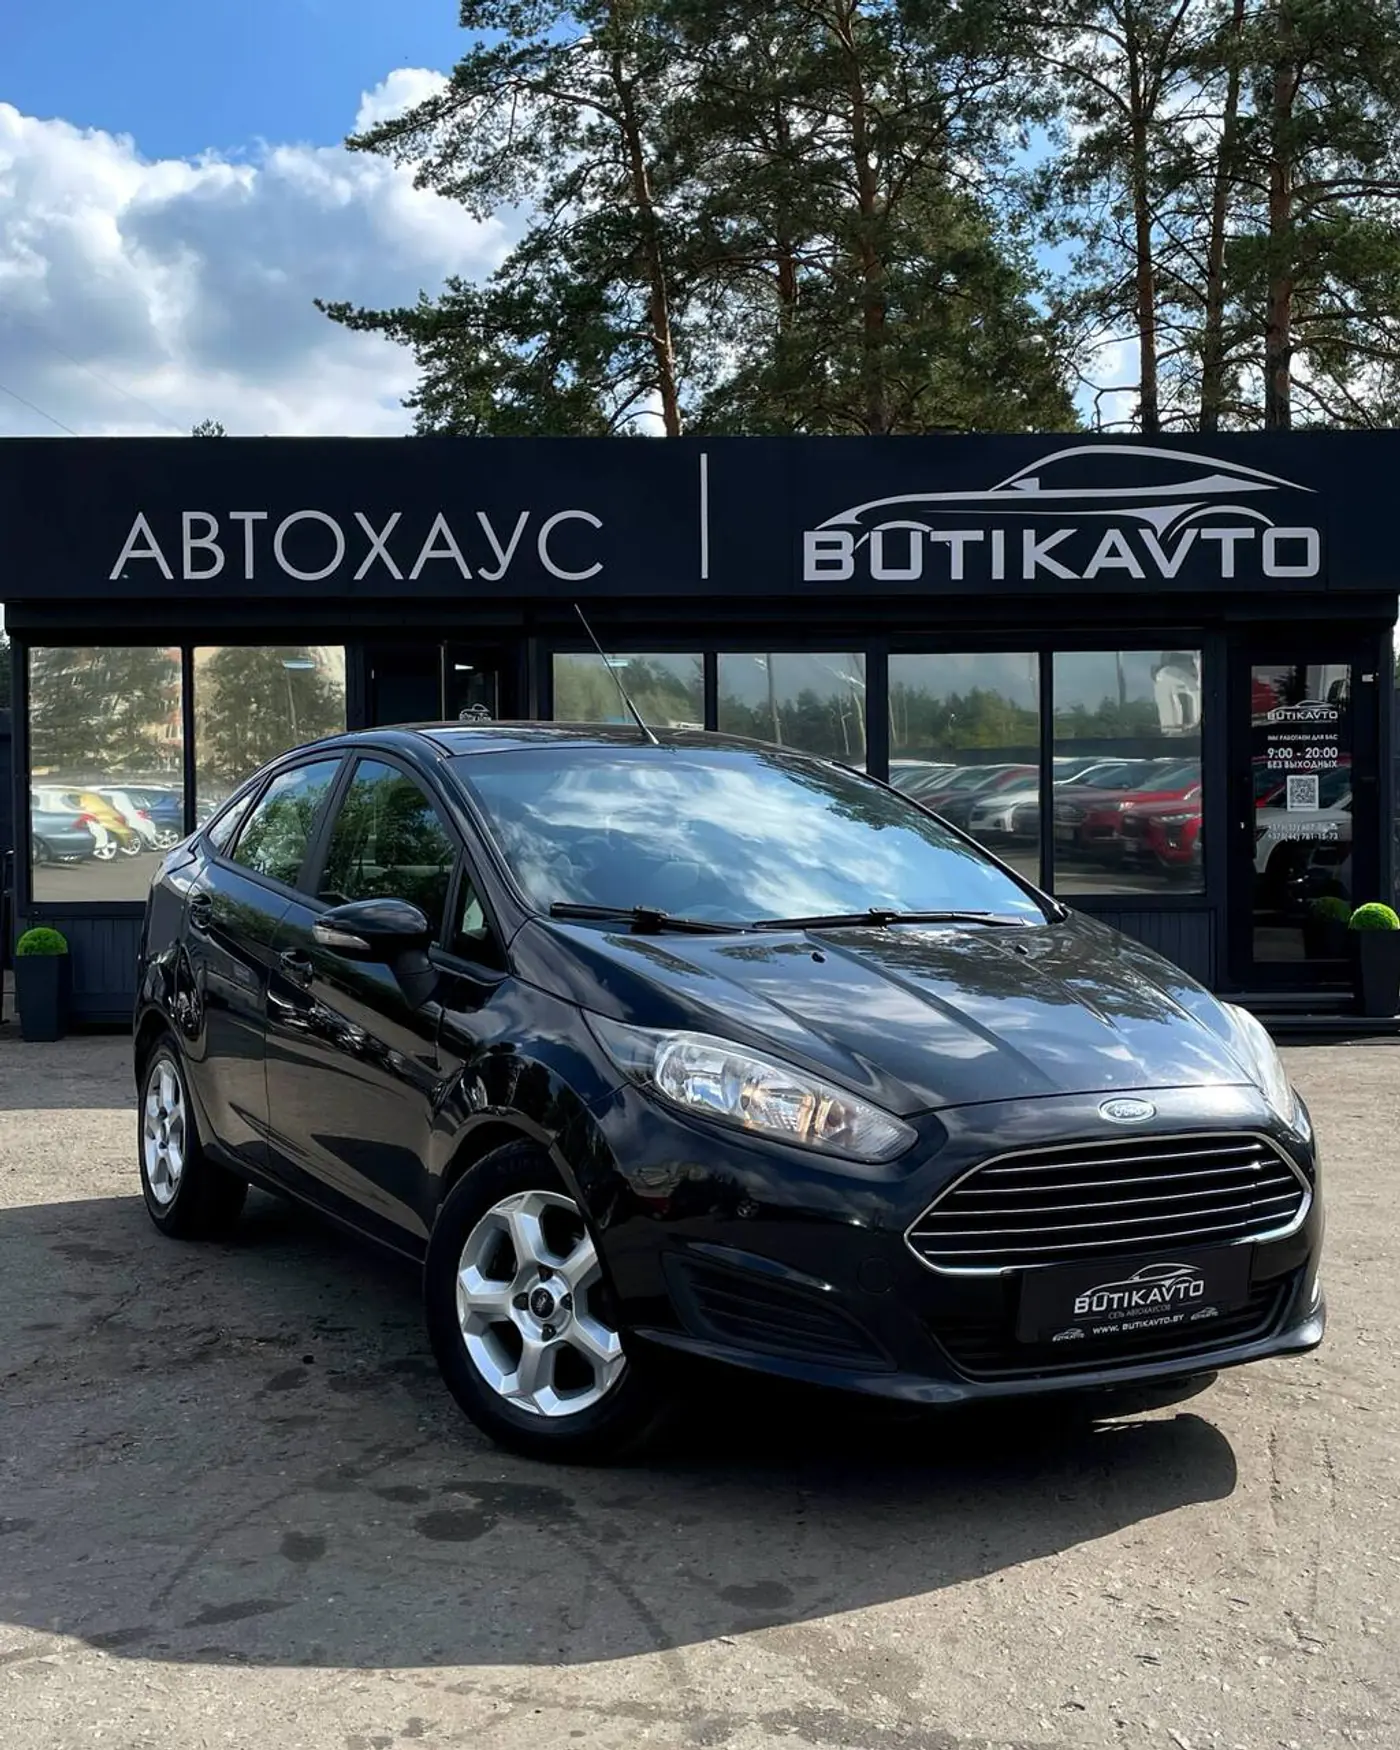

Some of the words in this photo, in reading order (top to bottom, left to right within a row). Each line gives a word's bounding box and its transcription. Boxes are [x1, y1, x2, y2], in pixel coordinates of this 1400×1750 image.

[108, 509, 604, 581] АВТОХАУС
[803, 526, 1320, 582] BUTIKAVTO
[1267, 710, 1339, 720] BUTIKAVTO
[1267, 747, 1293, 759] 9:00
[1305, 746, 1339, 759] 20:00
[1267, 761, 1282, 769] БЕЗ
[1284, 760, 1338, 769] ВЫХОДНЫХ
[1074, 1280, 1204, 1314] BUTIKAVTO
